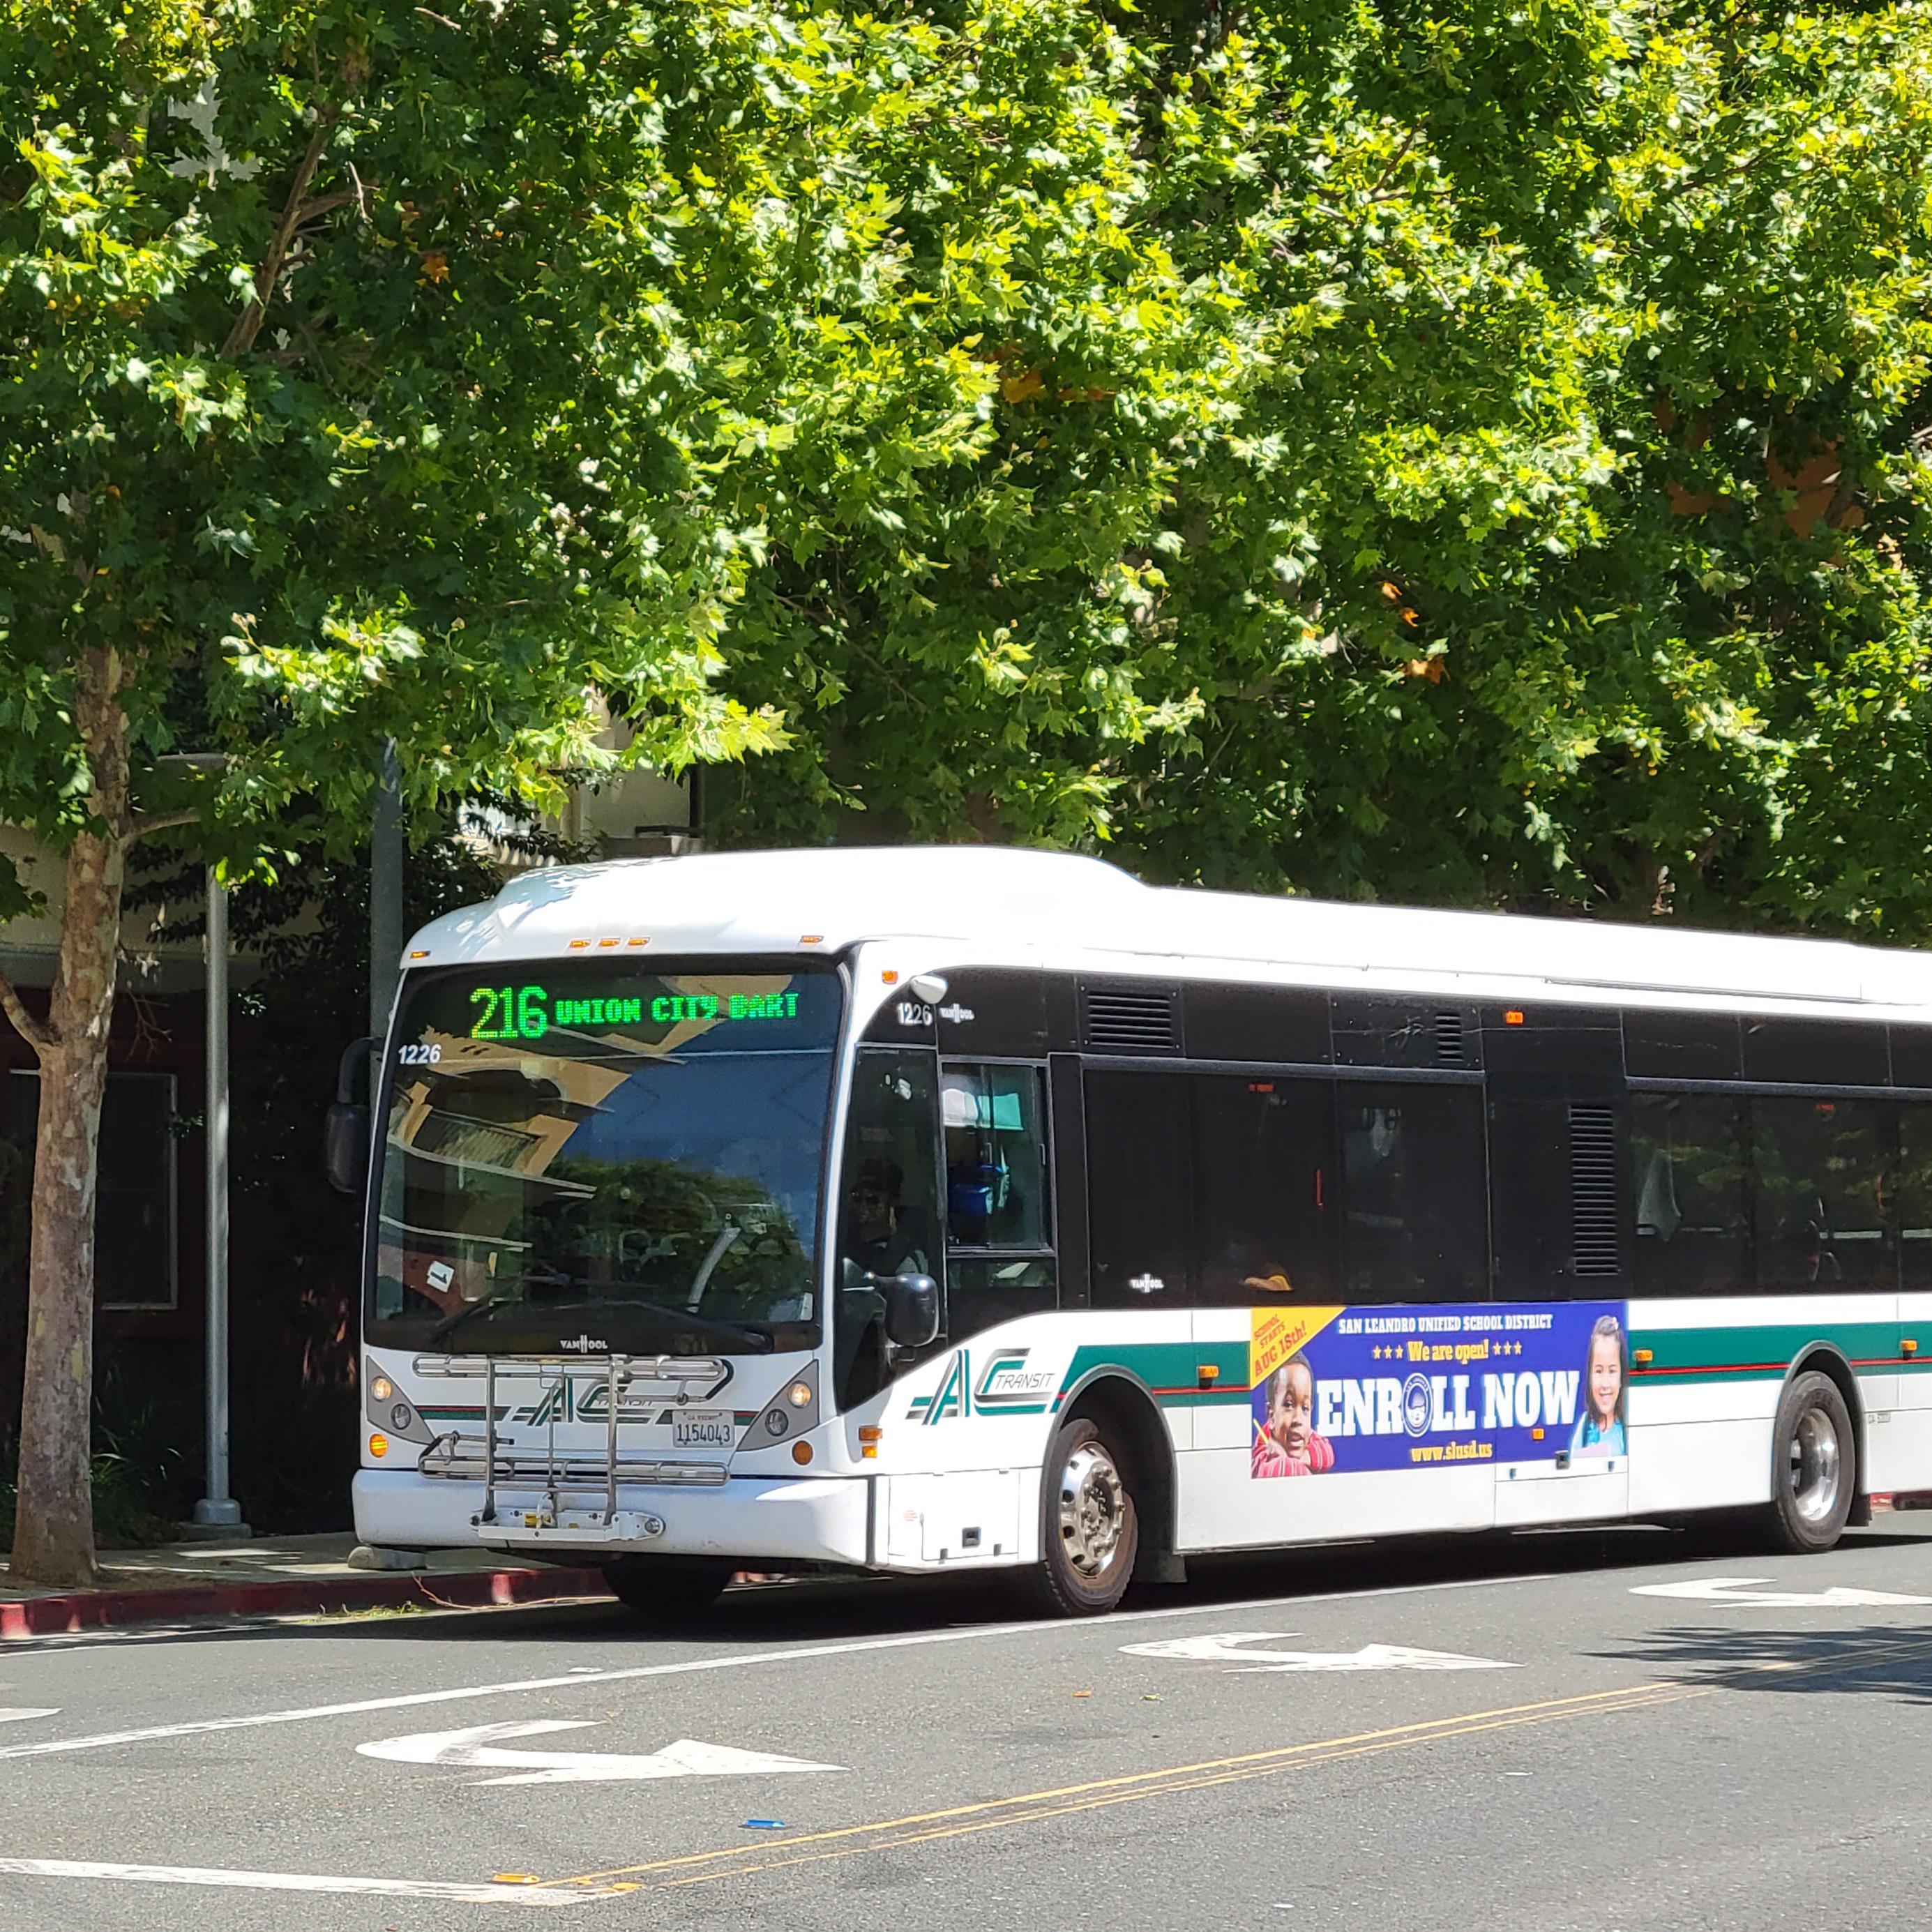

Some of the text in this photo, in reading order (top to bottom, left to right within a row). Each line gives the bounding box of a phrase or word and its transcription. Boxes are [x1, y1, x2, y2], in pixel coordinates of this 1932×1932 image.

[469, 986, 799, 1039] 216 UNION CITY BART
[897, 1002, 933, 1026] 1226
[398, 1043, 442, 1064] 1226
[1338, 1313, 1553, 1334] SAN LEANDRO UNIFIED SCHOOL DISTRICT
[1255, 1345, 1278, 1379] AUG
[1408, 1338, 1489, 1365] We are open!
[995, 1373, 1056, 1390] TRANSIT
[1316, 1371, 1580, 1438] ENROLL NOW
[677, 1424, 730, 1442] 1154043
[1411, 1440, 1493, 1463] www.slusd.us
